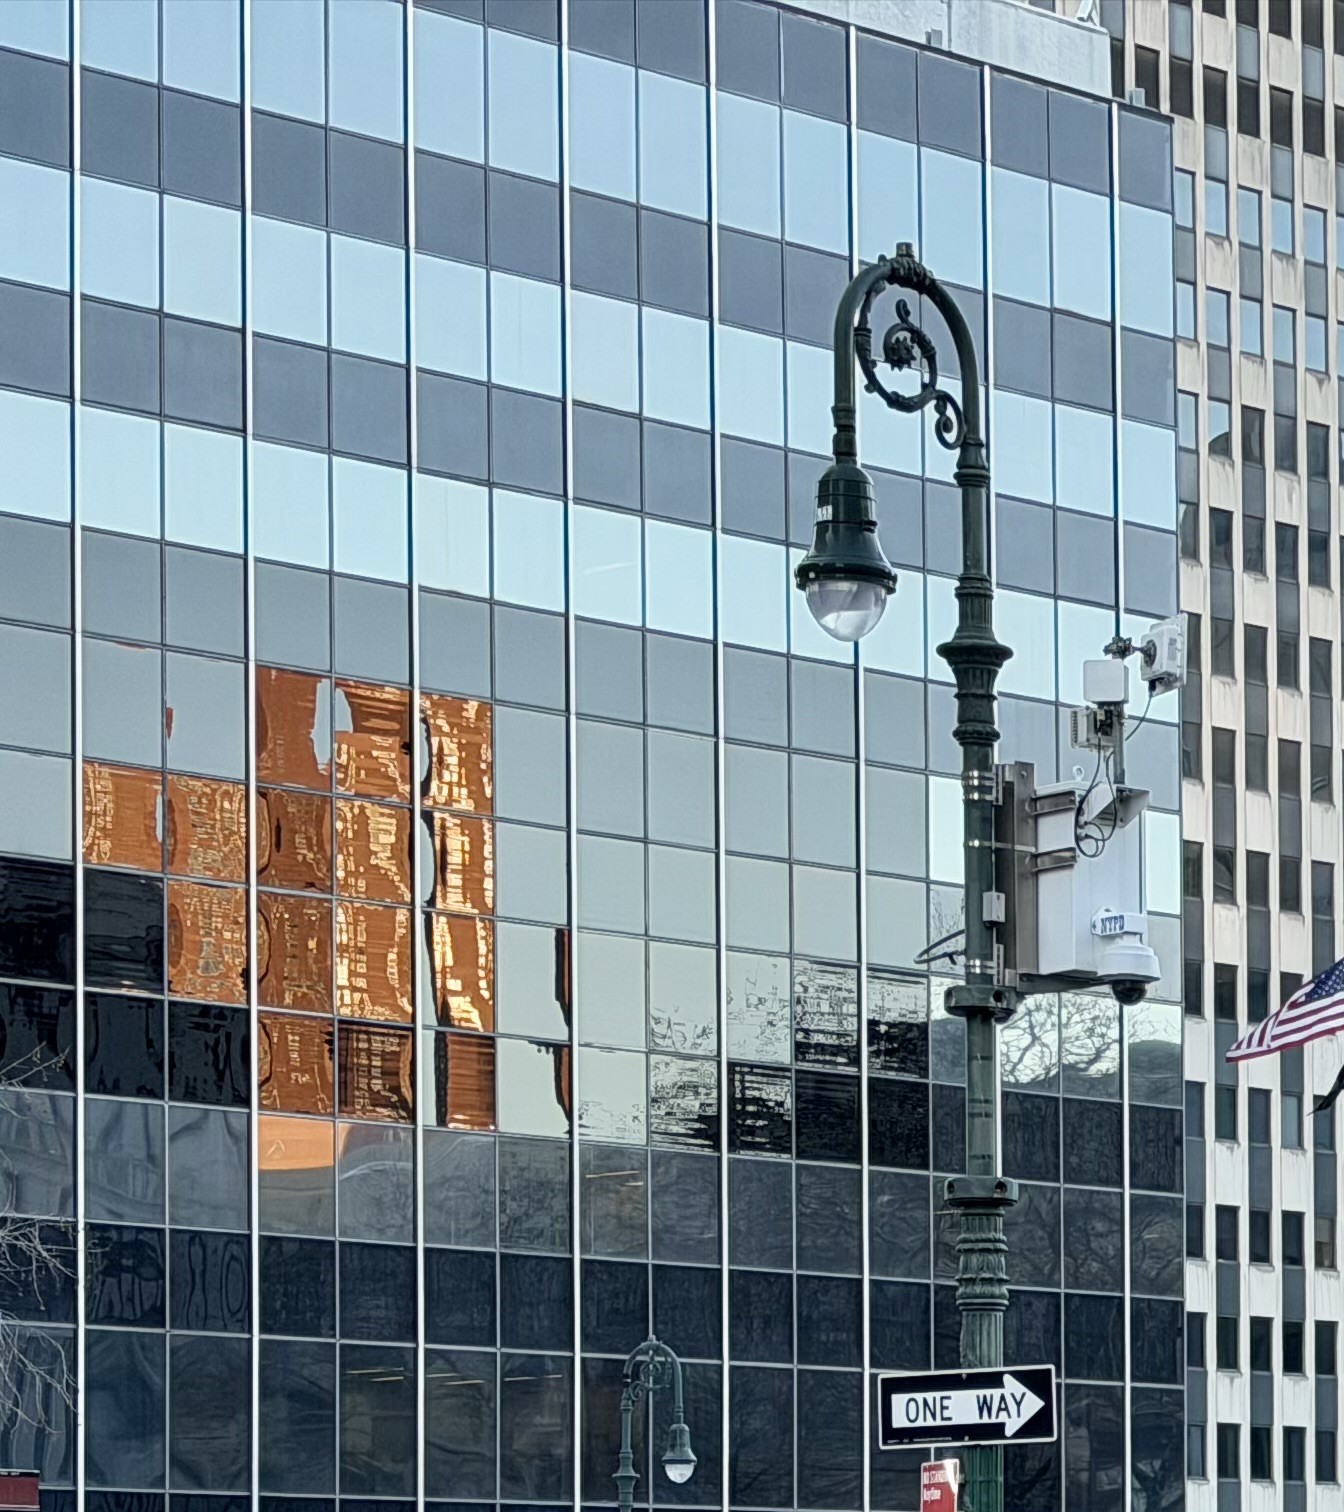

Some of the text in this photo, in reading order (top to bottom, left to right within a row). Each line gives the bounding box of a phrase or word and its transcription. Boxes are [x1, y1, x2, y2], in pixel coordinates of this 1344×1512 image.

[1101, 915, 1124, 934] NYPD
[905, 1391, 1026, 1423] ONE WAY
